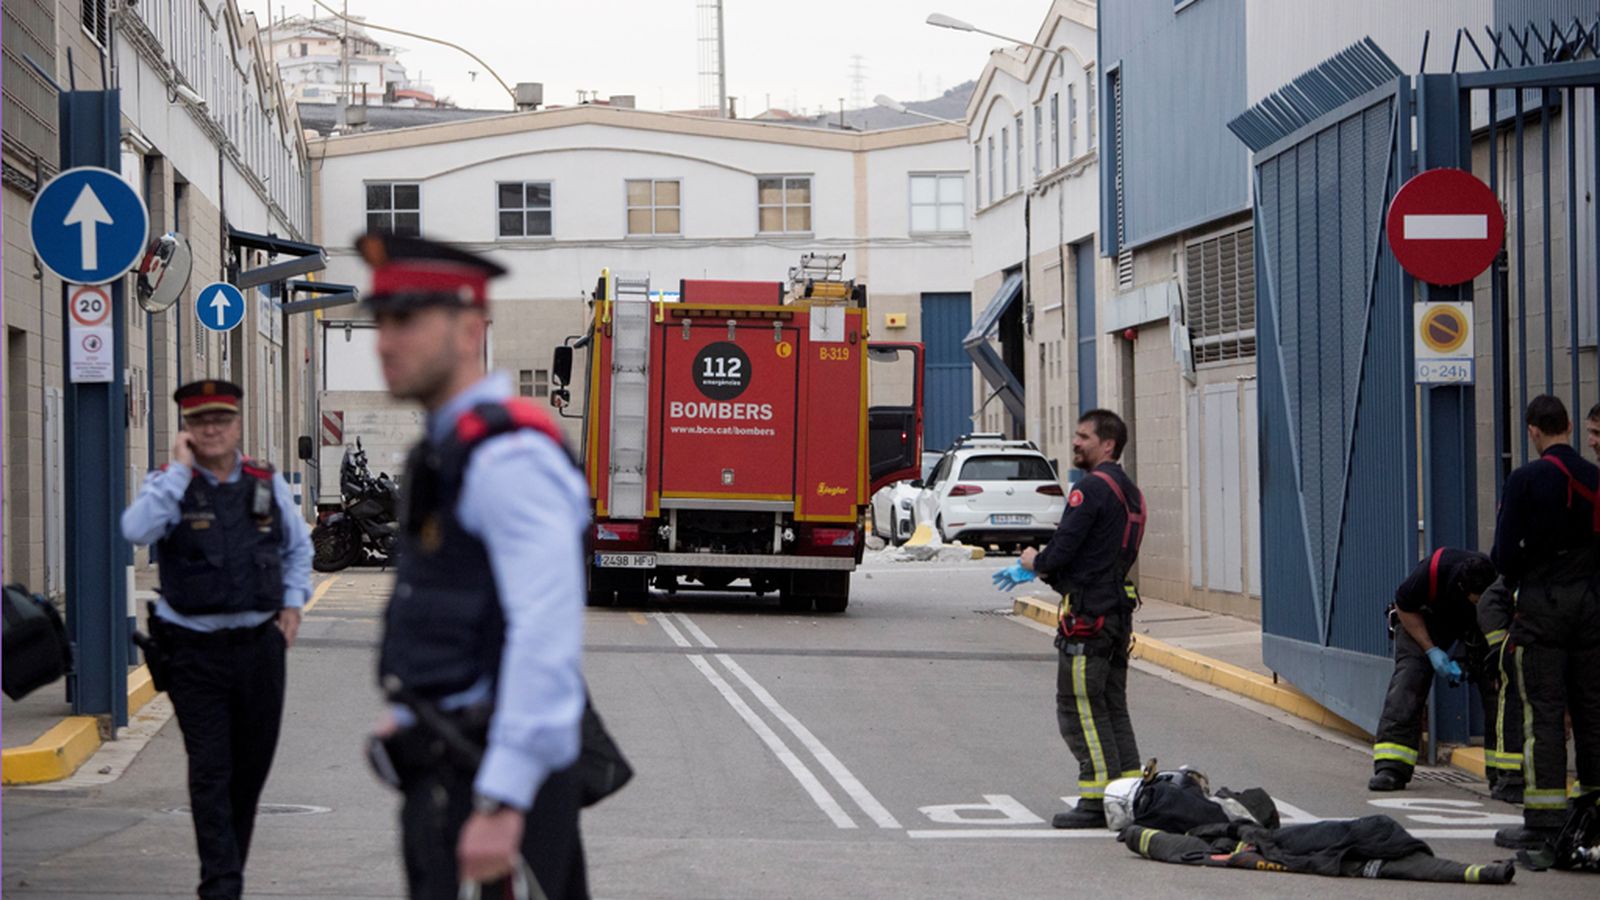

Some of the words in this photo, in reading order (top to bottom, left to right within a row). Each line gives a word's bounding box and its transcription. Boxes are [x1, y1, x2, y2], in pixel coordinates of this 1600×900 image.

[80, 300, 102, 312] 20
[820, 347, 849, 360] B-319
[703, 357, 741, 377] 112
[670, 402, 773, 420] BOMBERS
[671, 426, 775, 435] www.bcn.cat/bombers
[603, 556, 629, 566] 2498
